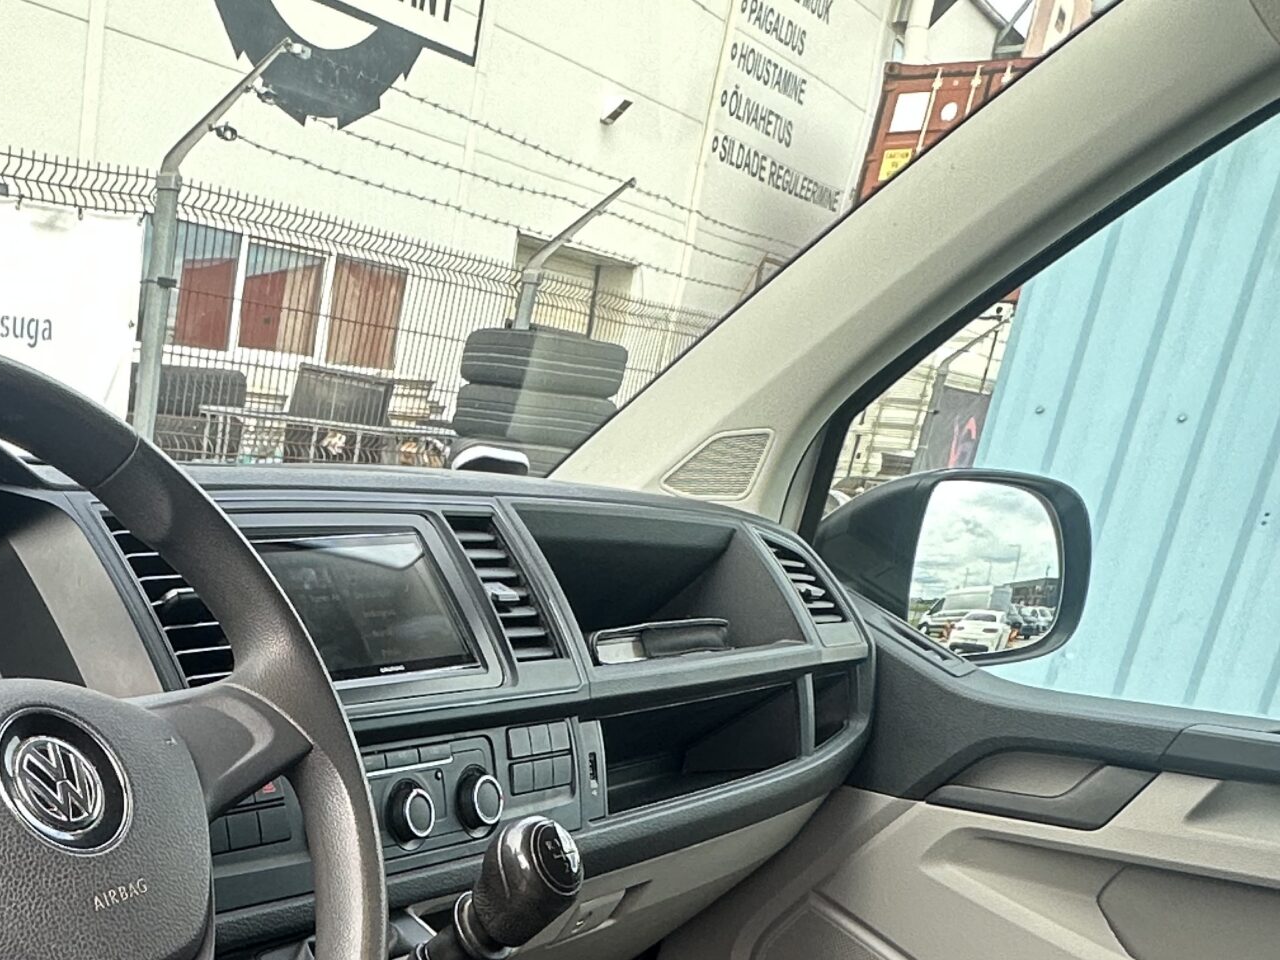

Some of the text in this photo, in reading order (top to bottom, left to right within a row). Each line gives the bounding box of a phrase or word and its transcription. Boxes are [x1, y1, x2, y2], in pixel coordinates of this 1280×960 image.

[747, 0, 807, 56] PAIGALDUS
[737, 42, 807, 105] HOIUSTAMINE
[719, 134, 767, 182] SILDADE
[93, 877, 149, 911] AIRBAG
